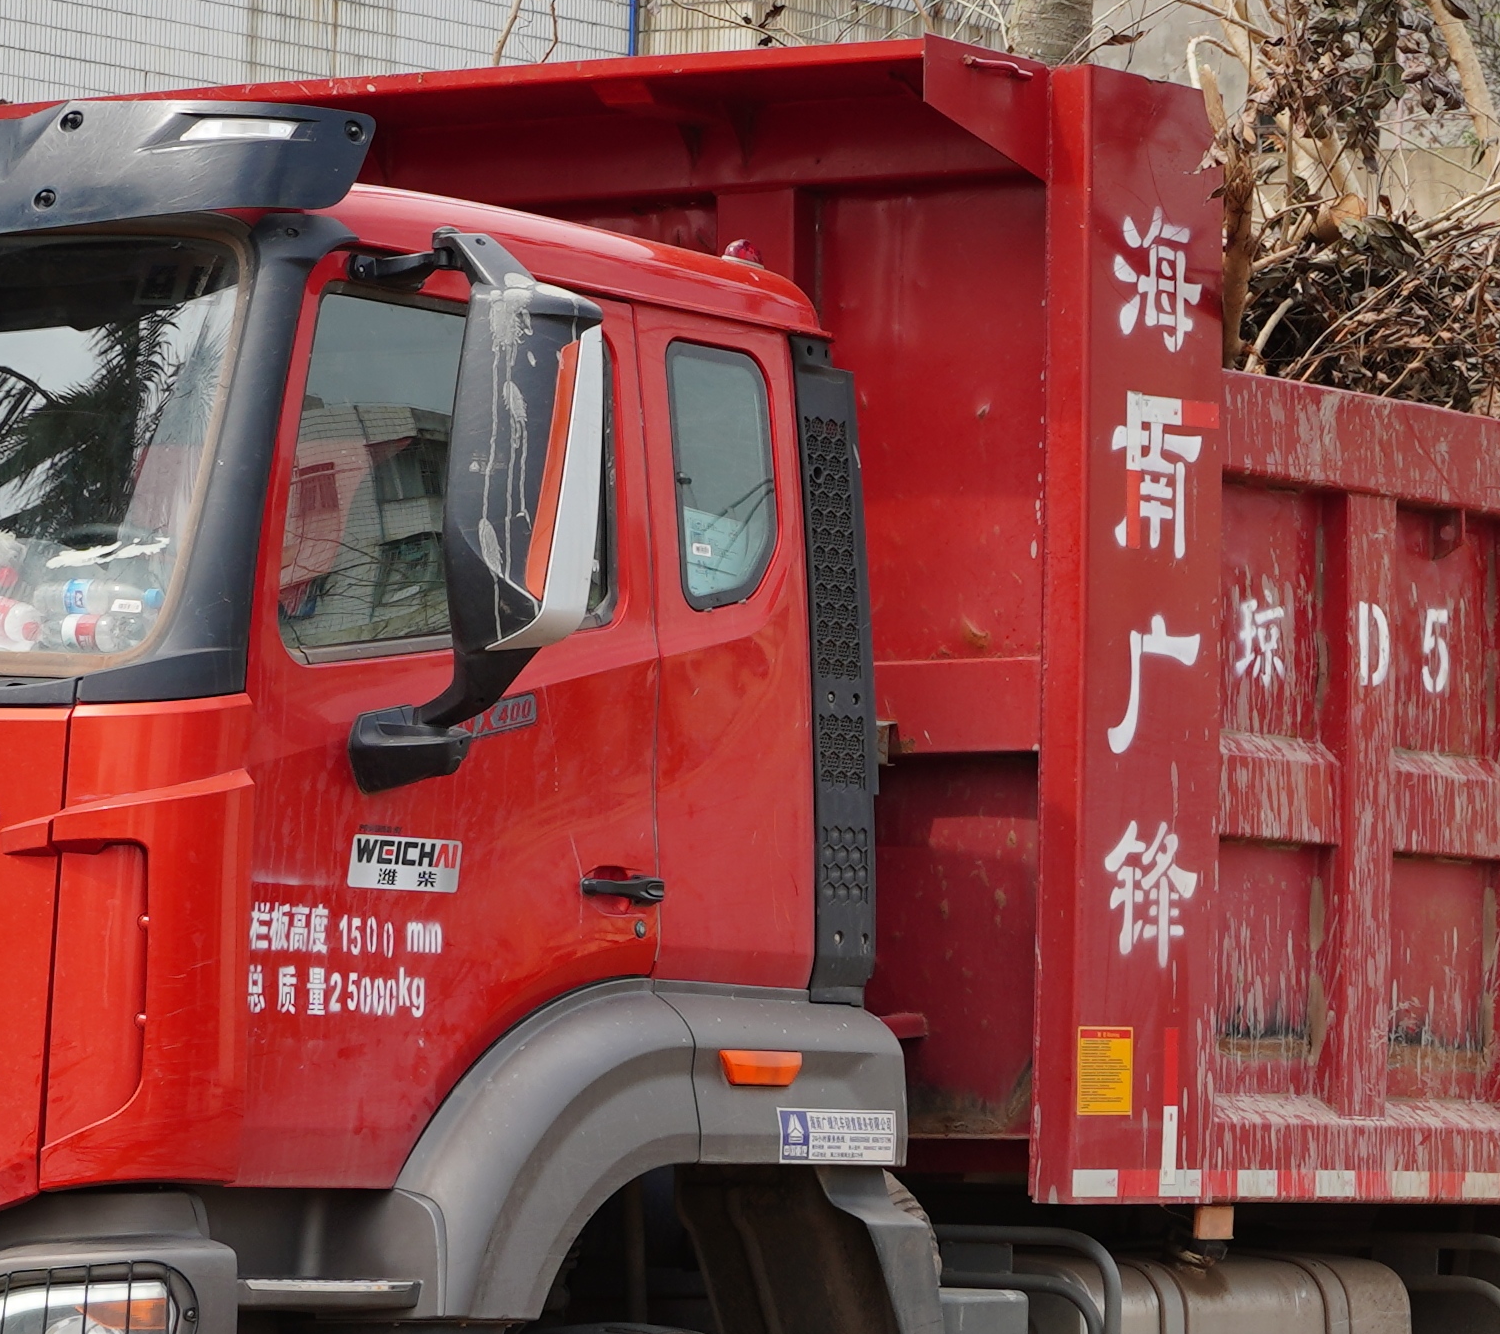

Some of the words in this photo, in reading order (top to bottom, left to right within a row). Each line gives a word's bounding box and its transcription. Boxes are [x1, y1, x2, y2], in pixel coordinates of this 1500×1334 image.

[357, 837, 459, 869] WEICHAI
[377, 868, 437, 887] 潍柴
[250, 902, 330, 954] 栏板高度
[339, 914, 394, 958] 1500
[406, 921, 443, 954] mm
